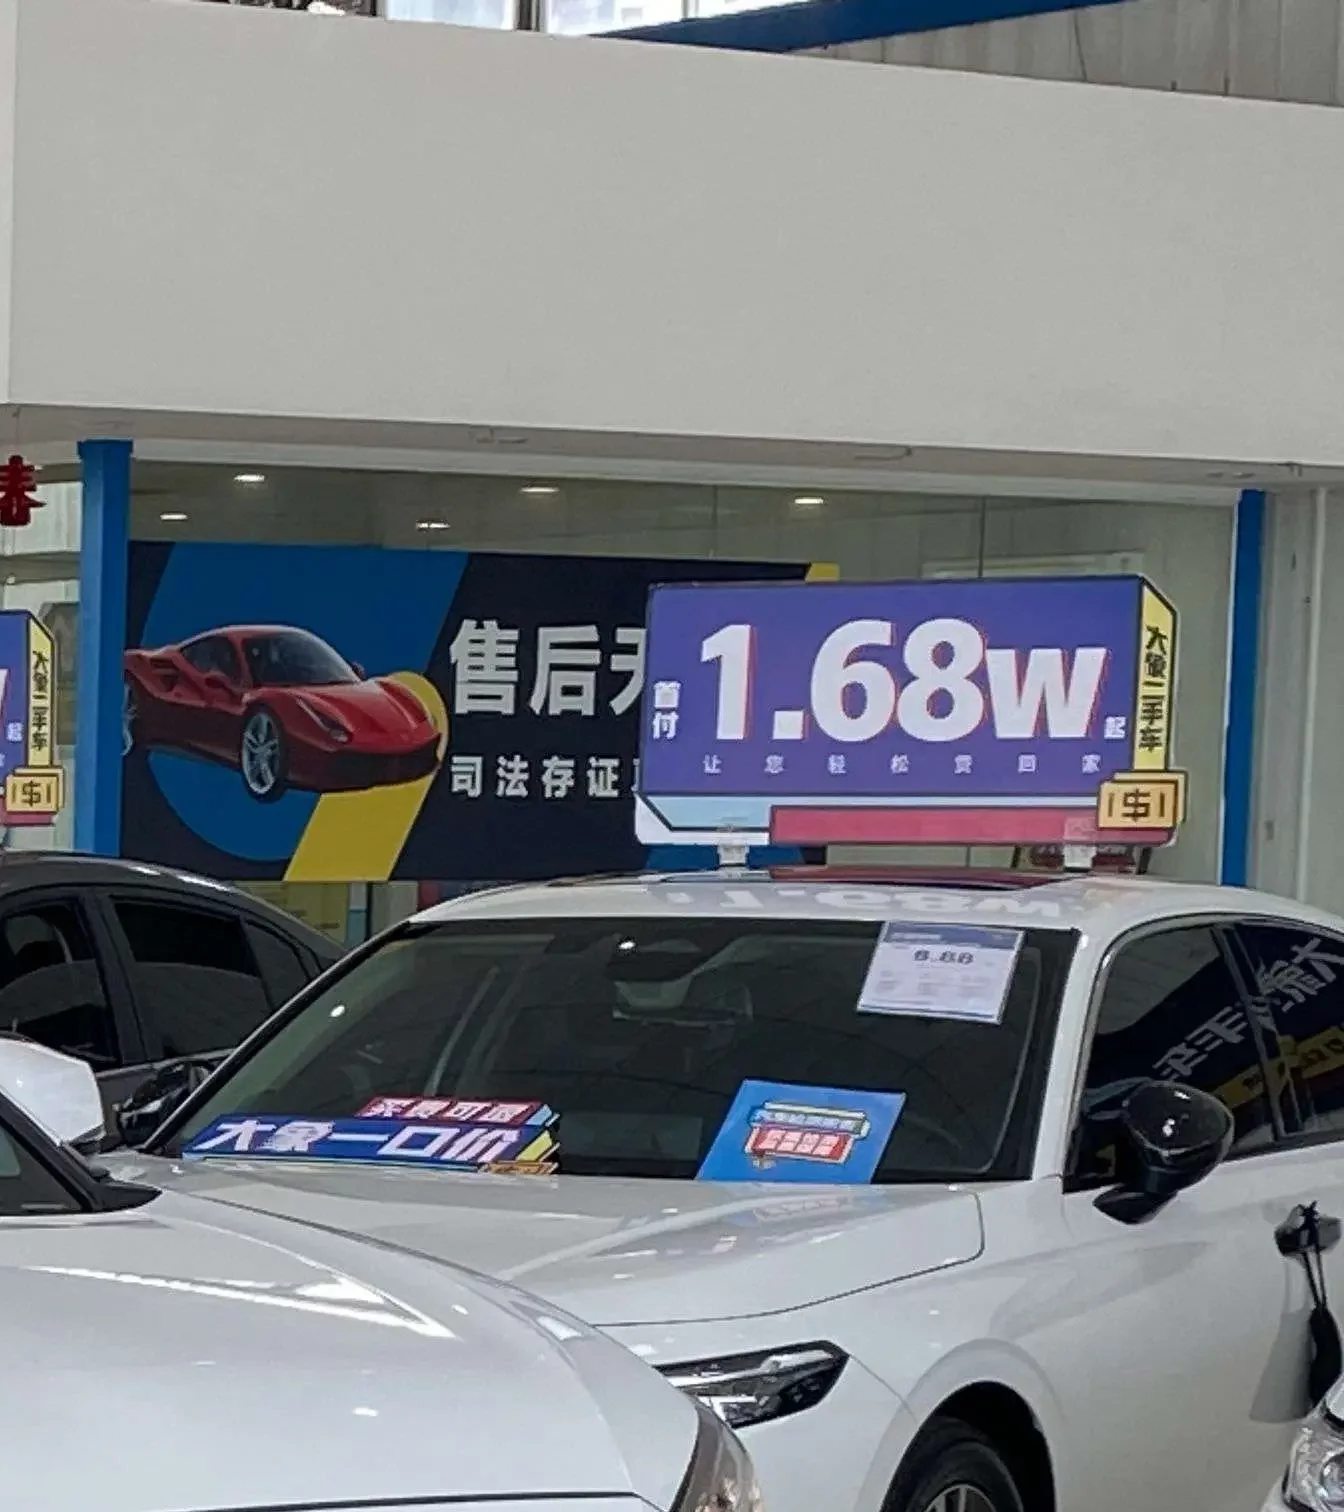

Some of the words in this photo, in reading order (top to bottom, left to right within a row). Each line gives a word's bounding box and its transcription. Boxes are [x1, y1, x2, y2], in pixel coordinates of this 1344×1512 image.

[651, 680, 682, 740] 首付
[1104, 716, 1126, 741] 起
[450, 755, 641, 798] 司法存证
[193, 1119, 521, 1162] 大象一口价
